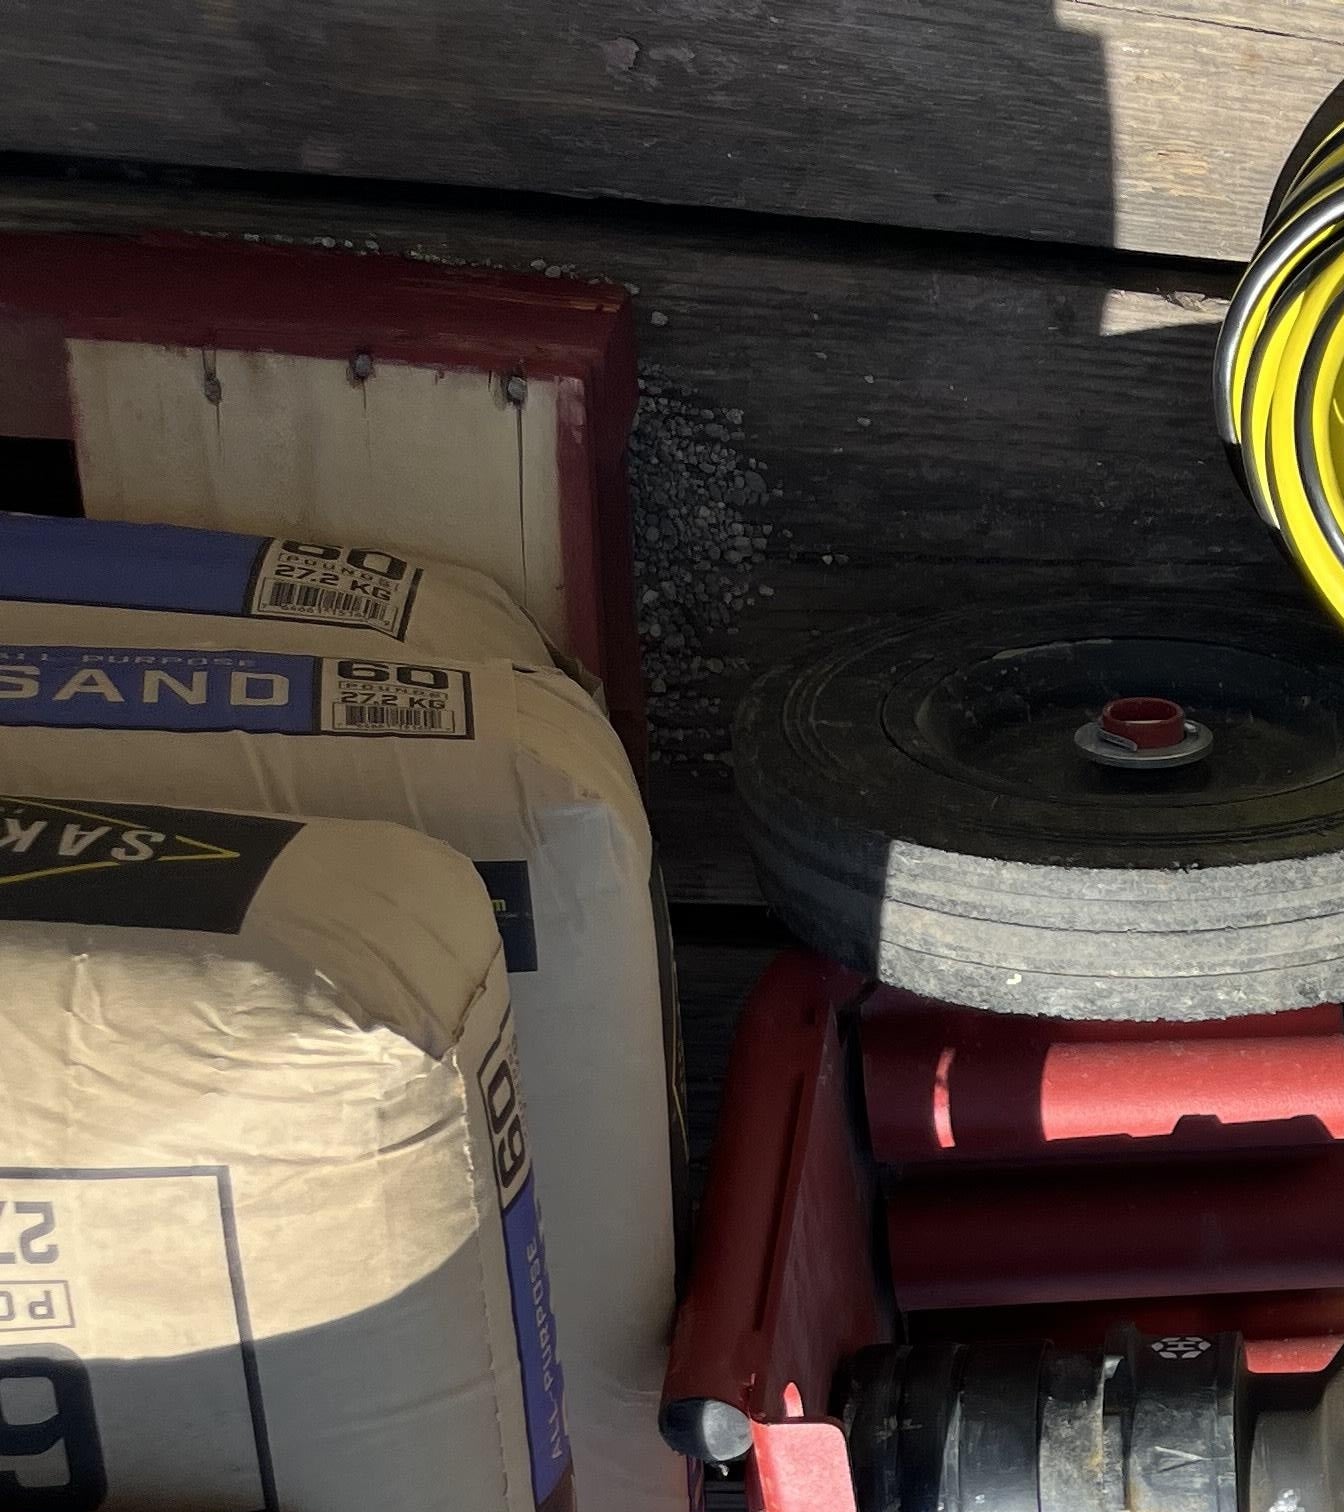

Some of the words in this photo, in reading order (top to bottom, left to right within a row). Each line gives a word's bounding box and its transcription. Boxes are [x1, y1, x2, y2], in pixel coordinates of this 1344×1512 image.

[274, 563, 340, 586] 27.2
[350, 580, 392, 601] KG
[0, 664, 290, 707] SAND
[338, 660, 449, 690] 60
[340, 691, 399, 707] 27.2
[408, 697, 446, 710] KG
[487, 1059, 526, 1188] 60
[526, 1235, 563, 1460] ALL-PURPOSE
